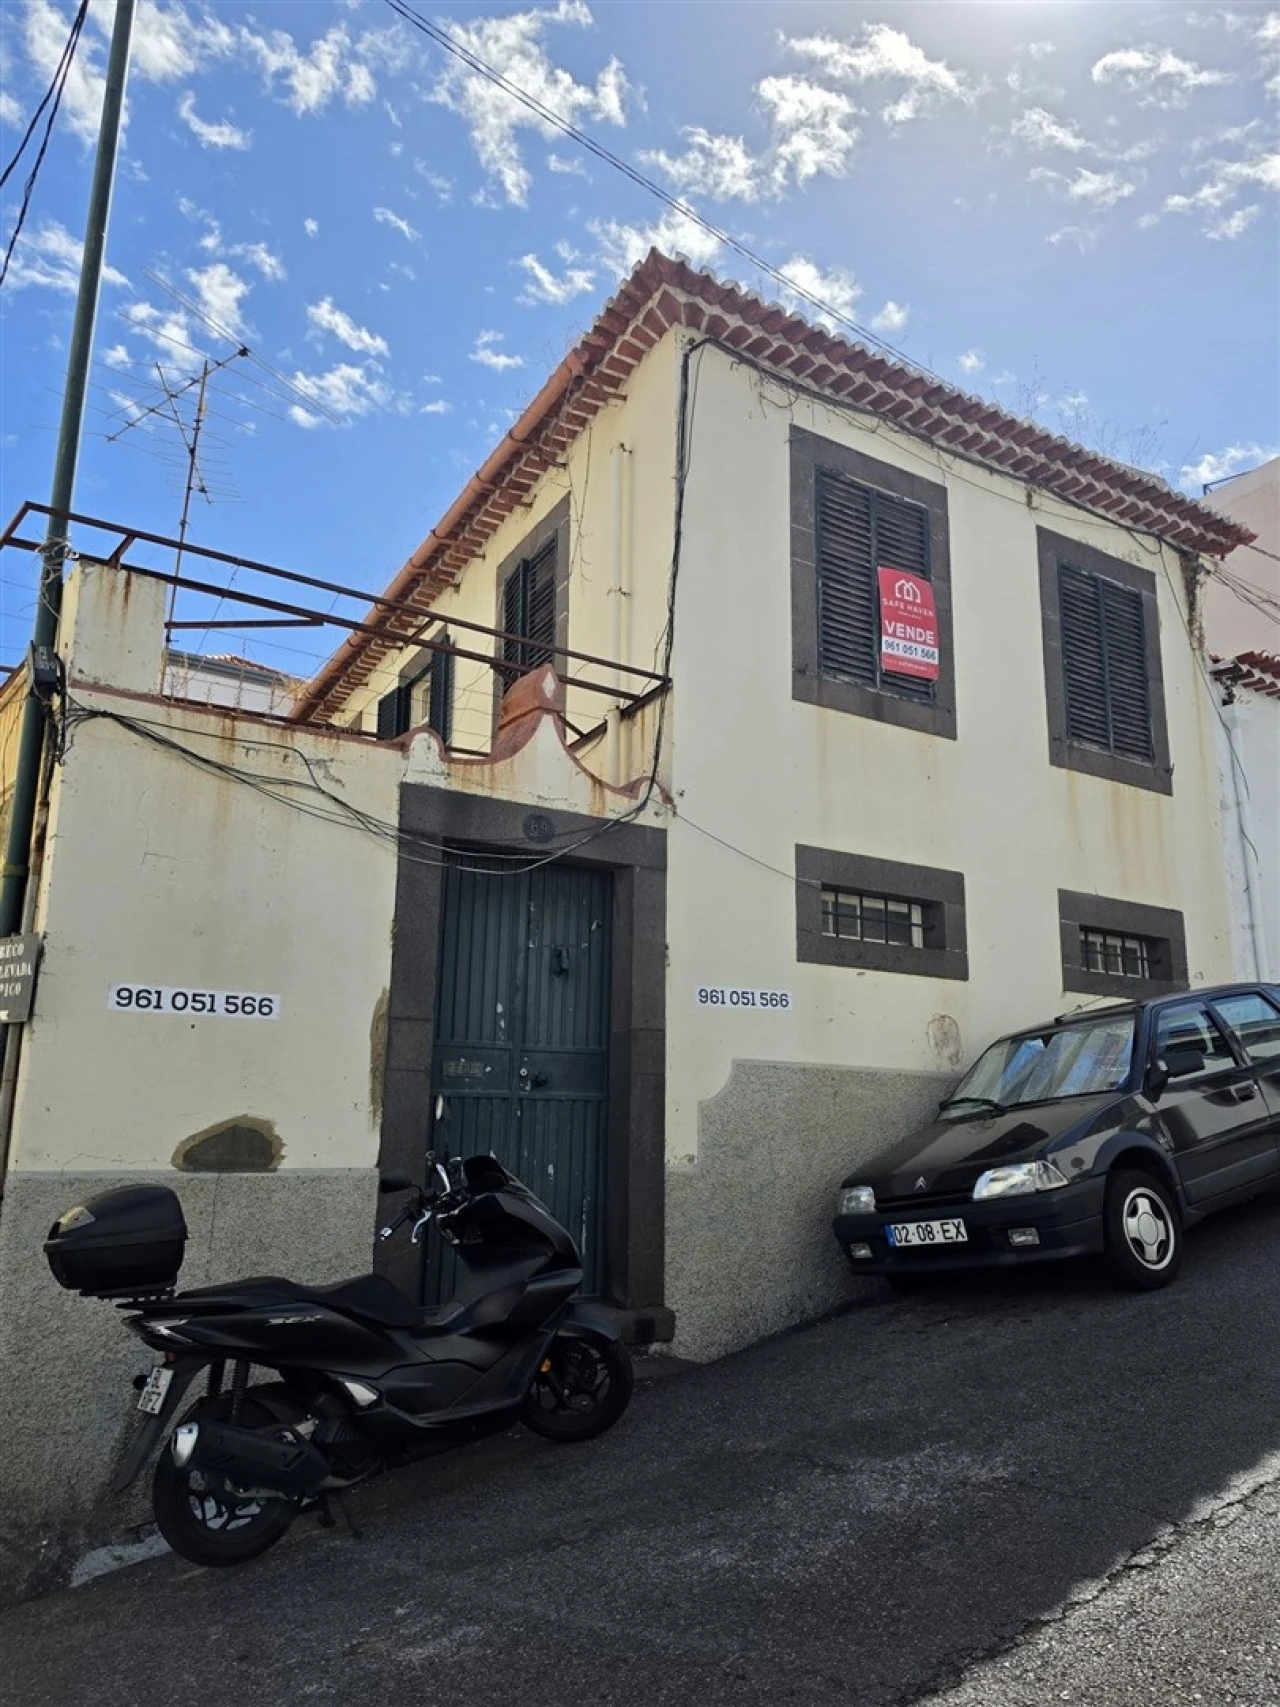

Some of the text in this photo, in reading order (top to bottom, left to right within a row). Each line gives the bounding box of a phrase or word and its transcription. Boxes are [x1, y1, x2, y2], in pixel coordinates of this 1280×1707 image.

[882, 598, 905, 610] SAFE
[906, 604, 934, 617] HAVEN
[884, 619, 935, 645] VENDE
[884, 639, 937, 661] 961 051 566
[115, 987, 274, 1017] 961 051 566
[698, 988, 789, 1008] 961 051 566
